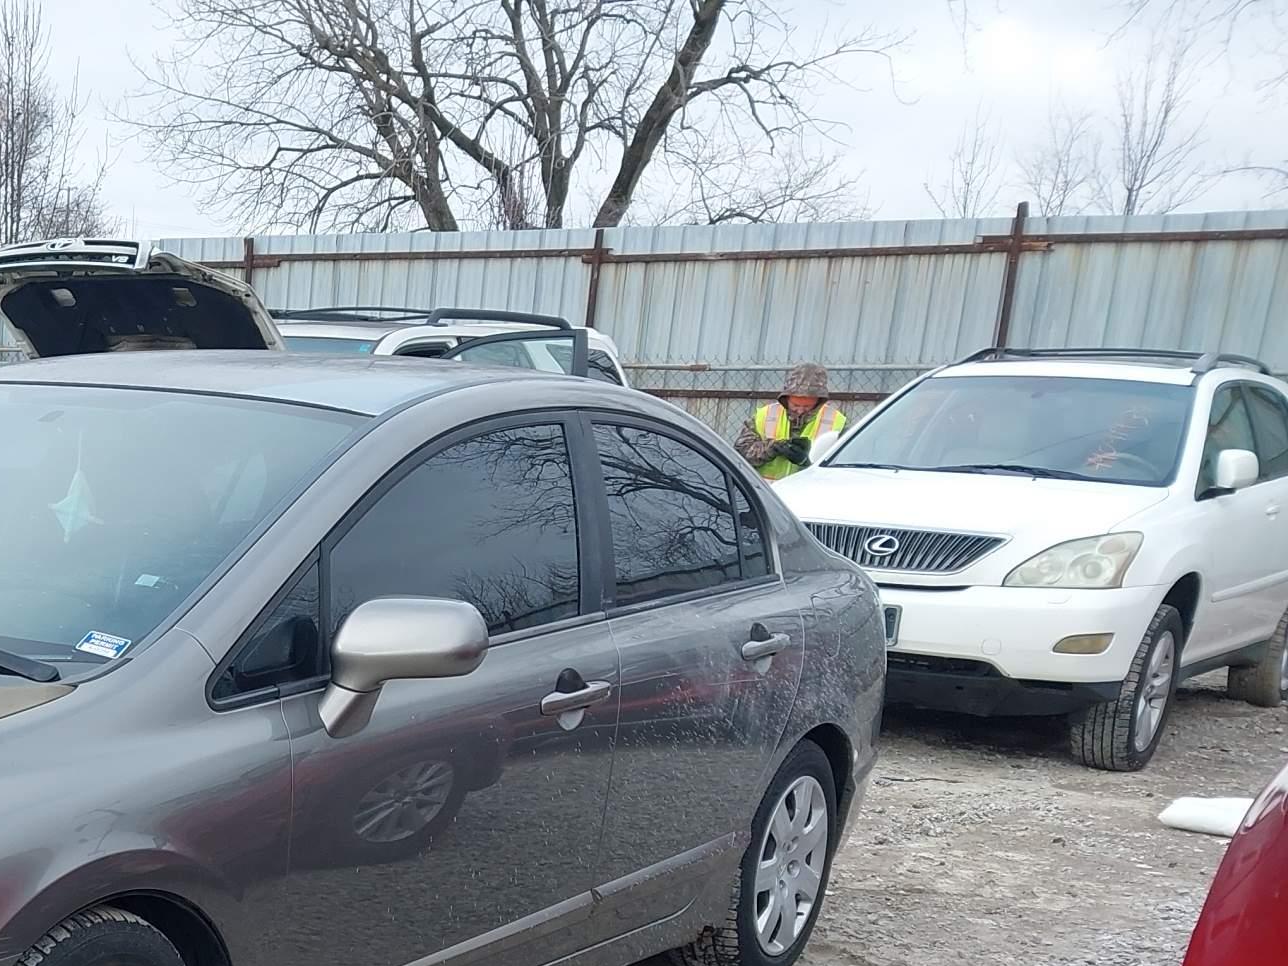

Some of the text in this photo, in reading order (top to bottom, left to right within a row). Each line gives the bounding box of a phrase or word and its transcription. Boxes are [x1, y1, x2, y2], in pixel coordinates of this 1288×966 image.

[111, 254, 129, 263] V8
[88, 638, 120, 650] PERMIT
[90, 632, 126, 646] PARKING
